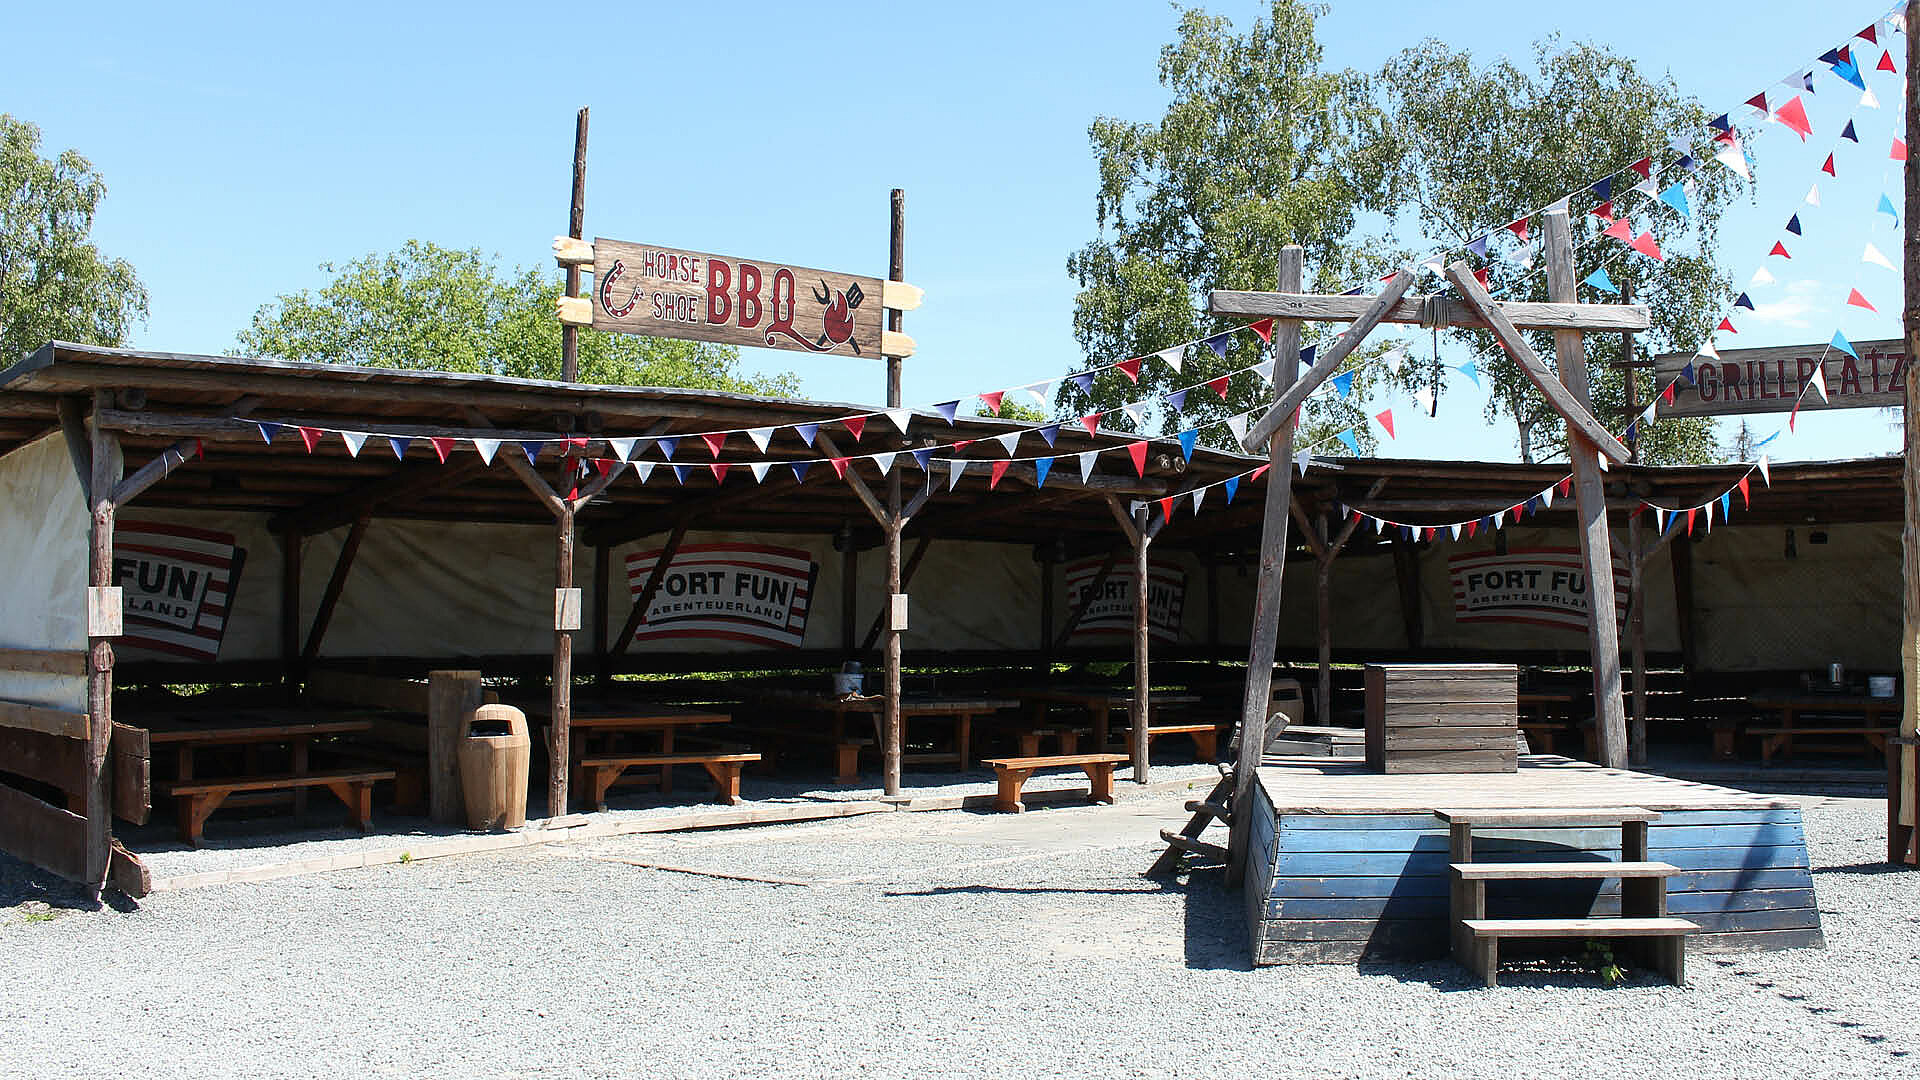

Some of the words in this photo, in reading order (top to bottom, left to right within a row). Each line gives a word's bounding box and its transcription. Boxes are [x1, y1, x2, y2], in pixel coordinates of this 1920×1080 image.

[643, 249, 701, 284] HORSE
[651, 292, 699, 324] SHOE
[705, 257, 838, 353] BBQ
[114, 559, 198, 602] FUN
[735, 572, 789, 606] FUN
[1468, 569, 1542, 593] FORT
[1551, 571, 1586, 594] FU
[652, 600, 786, 621] ABENTEUERLAND
